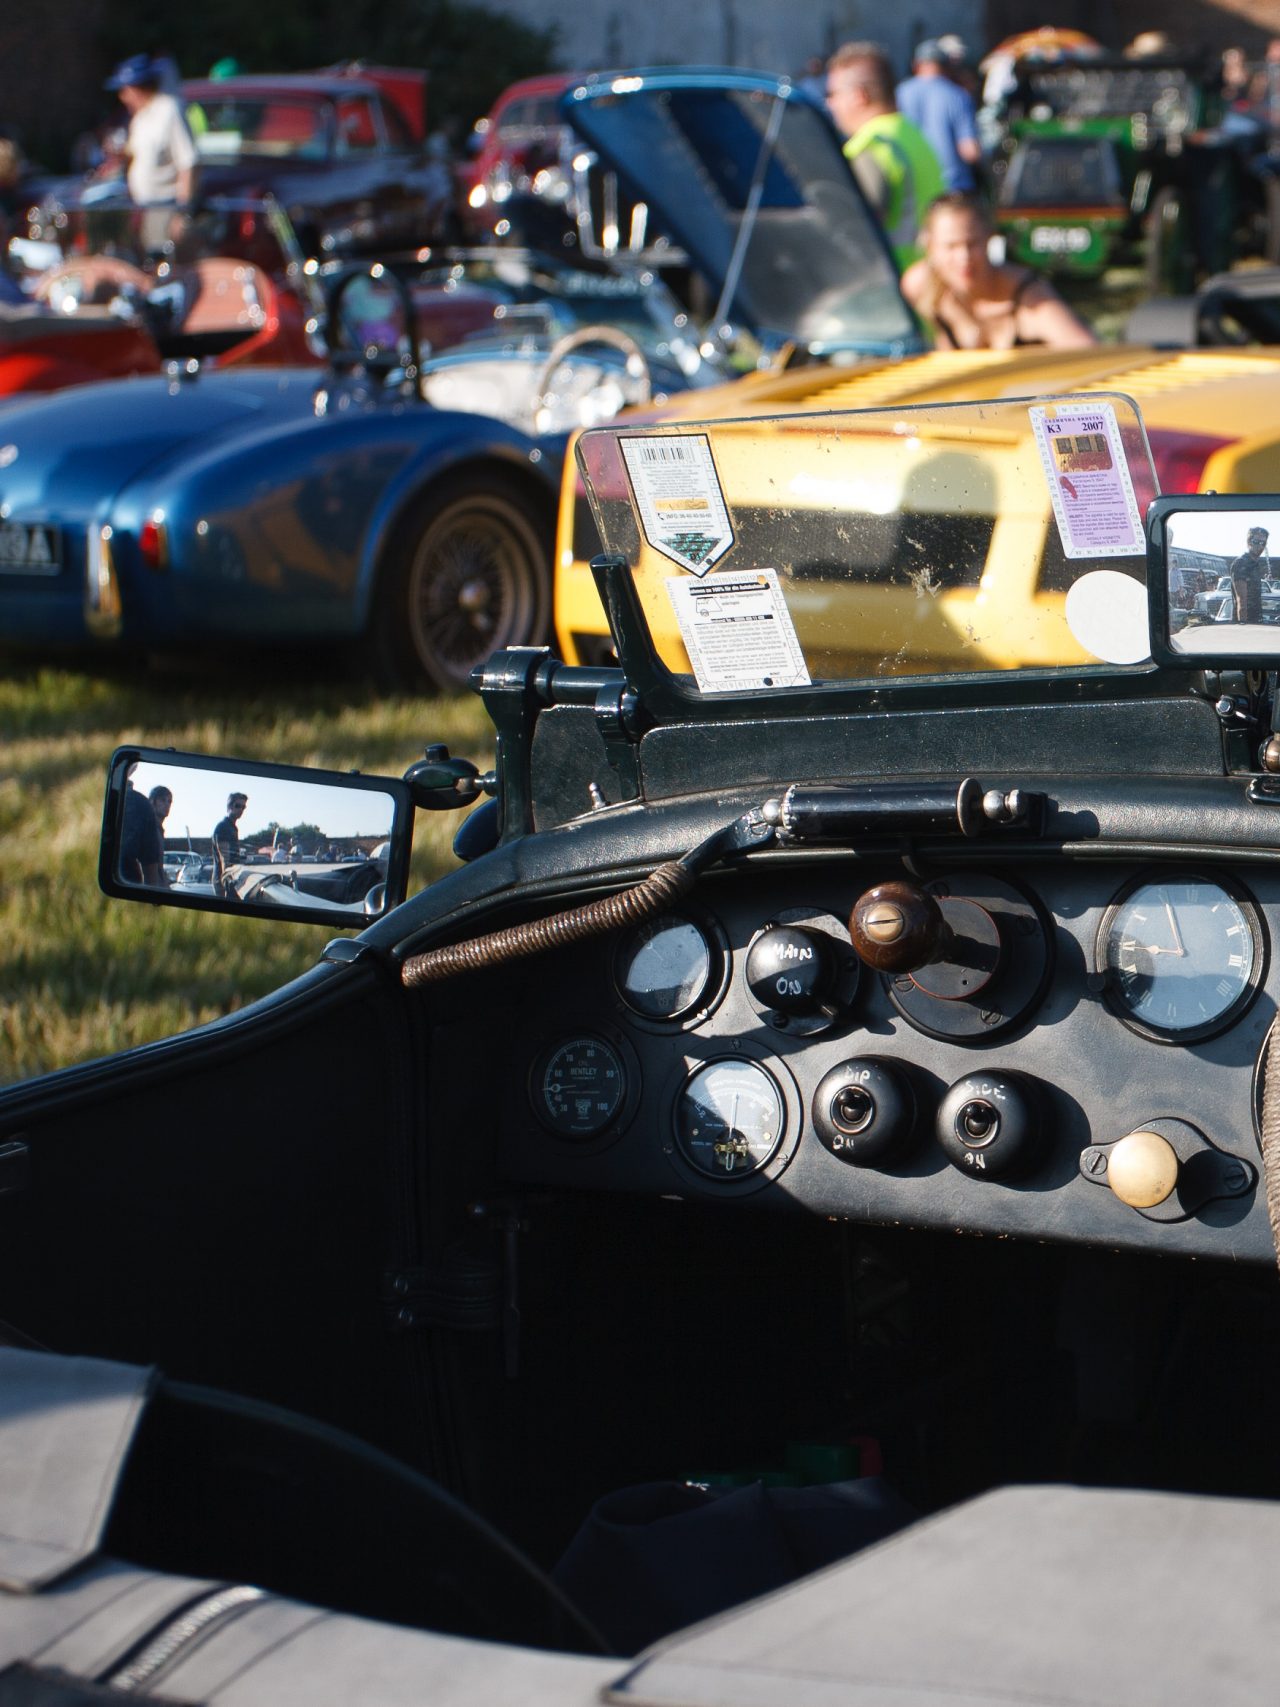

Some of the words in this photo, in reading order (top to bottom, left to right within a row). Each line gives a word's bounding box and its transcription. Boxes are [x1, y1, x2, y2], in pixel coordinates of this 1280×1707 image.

[1081, 421, 1104, 431] 2007
[773, 943, 812, 960] MAIN
[776, 977, 801, 996] ON
[597, 1103, 608, 1111] 100
